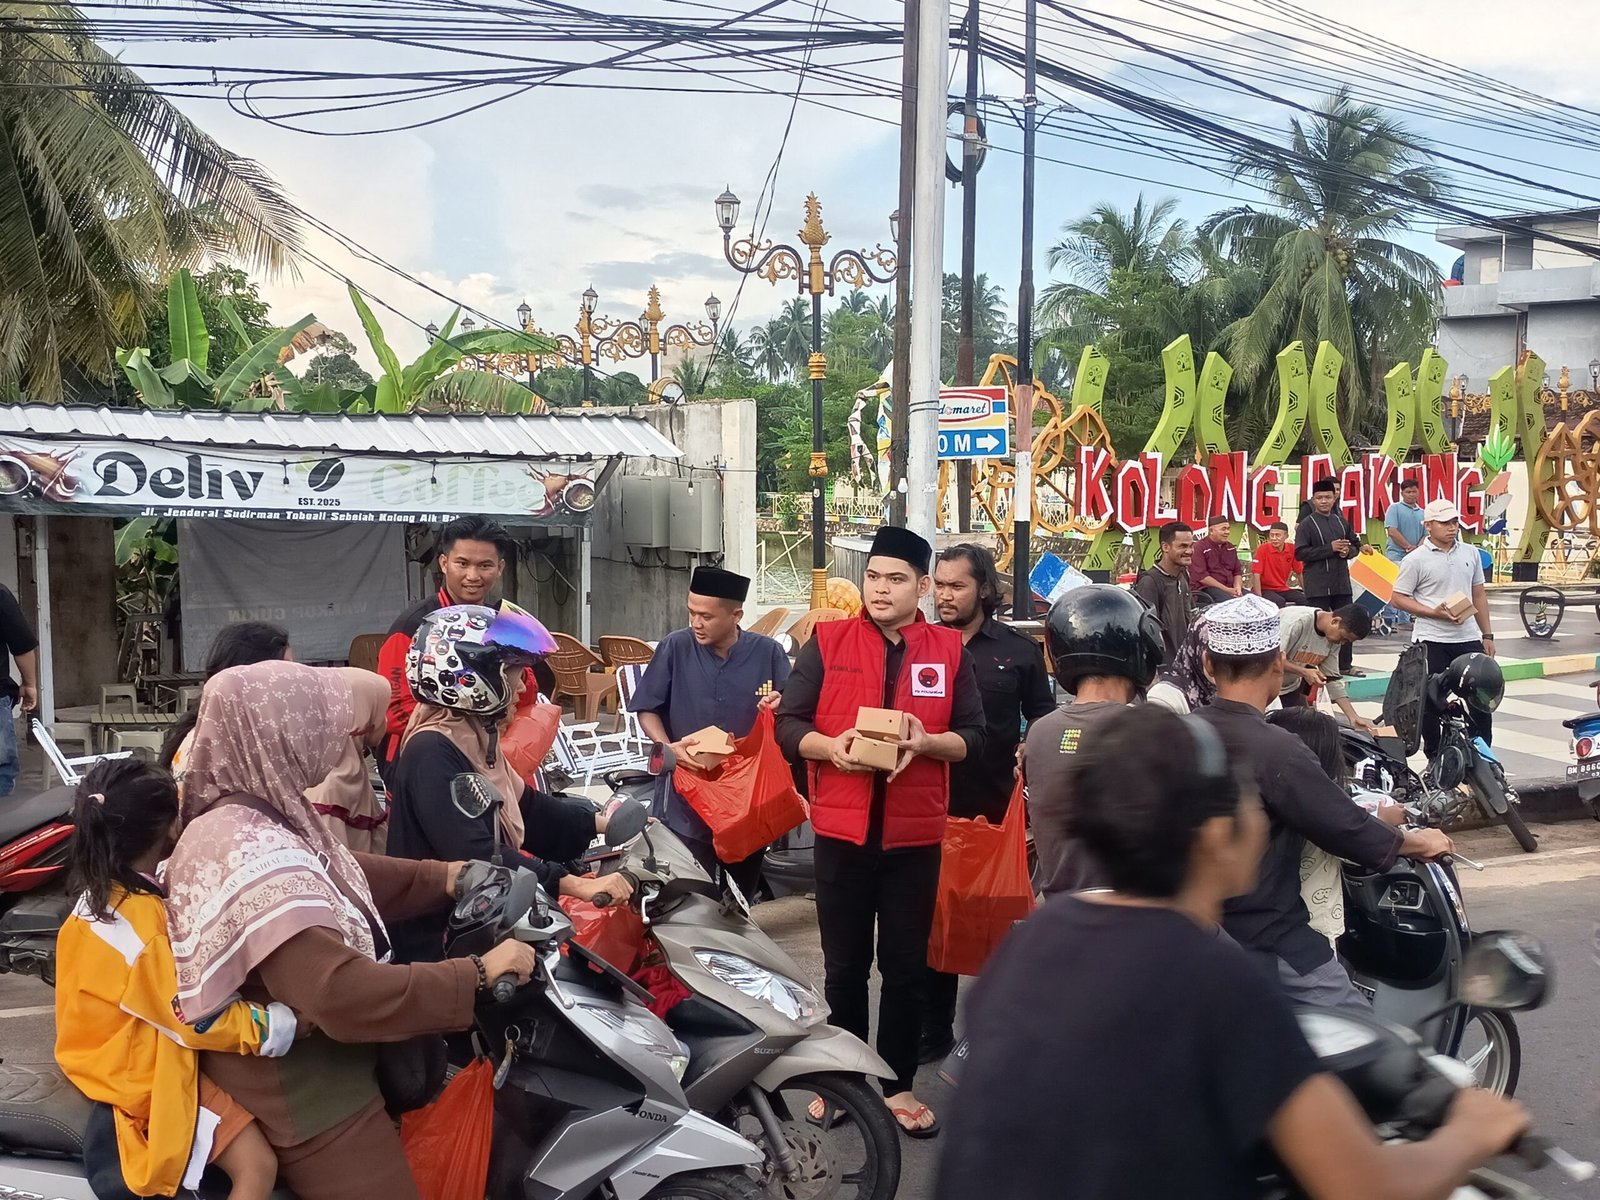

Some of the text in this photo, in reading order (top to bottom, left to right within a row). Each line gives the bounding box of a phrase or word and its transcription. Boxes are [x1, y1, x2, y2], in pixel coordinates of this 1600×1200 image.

[939, 403, 986, 415] domaret
[954, 433, 971, 452] M
[1075, 446, 1283, 533] KOLONG
[298, 498, 341, 507] EST. 2025
[141, 507, 158, 517] Jl.
[163, 507, 219, 518] Jenderal
[223, 509, 280, 519] Sudirman
[286, 511, 326, 521] Toboali
[331, 512, 374, 521] Sebelah
[378, 513, 416, 523] Kolong
[420, 513, 438, 523] Aik
[753, 1047, 785, 1055] SUZUKI
[638, 1109, 668, 1123] ONDA
